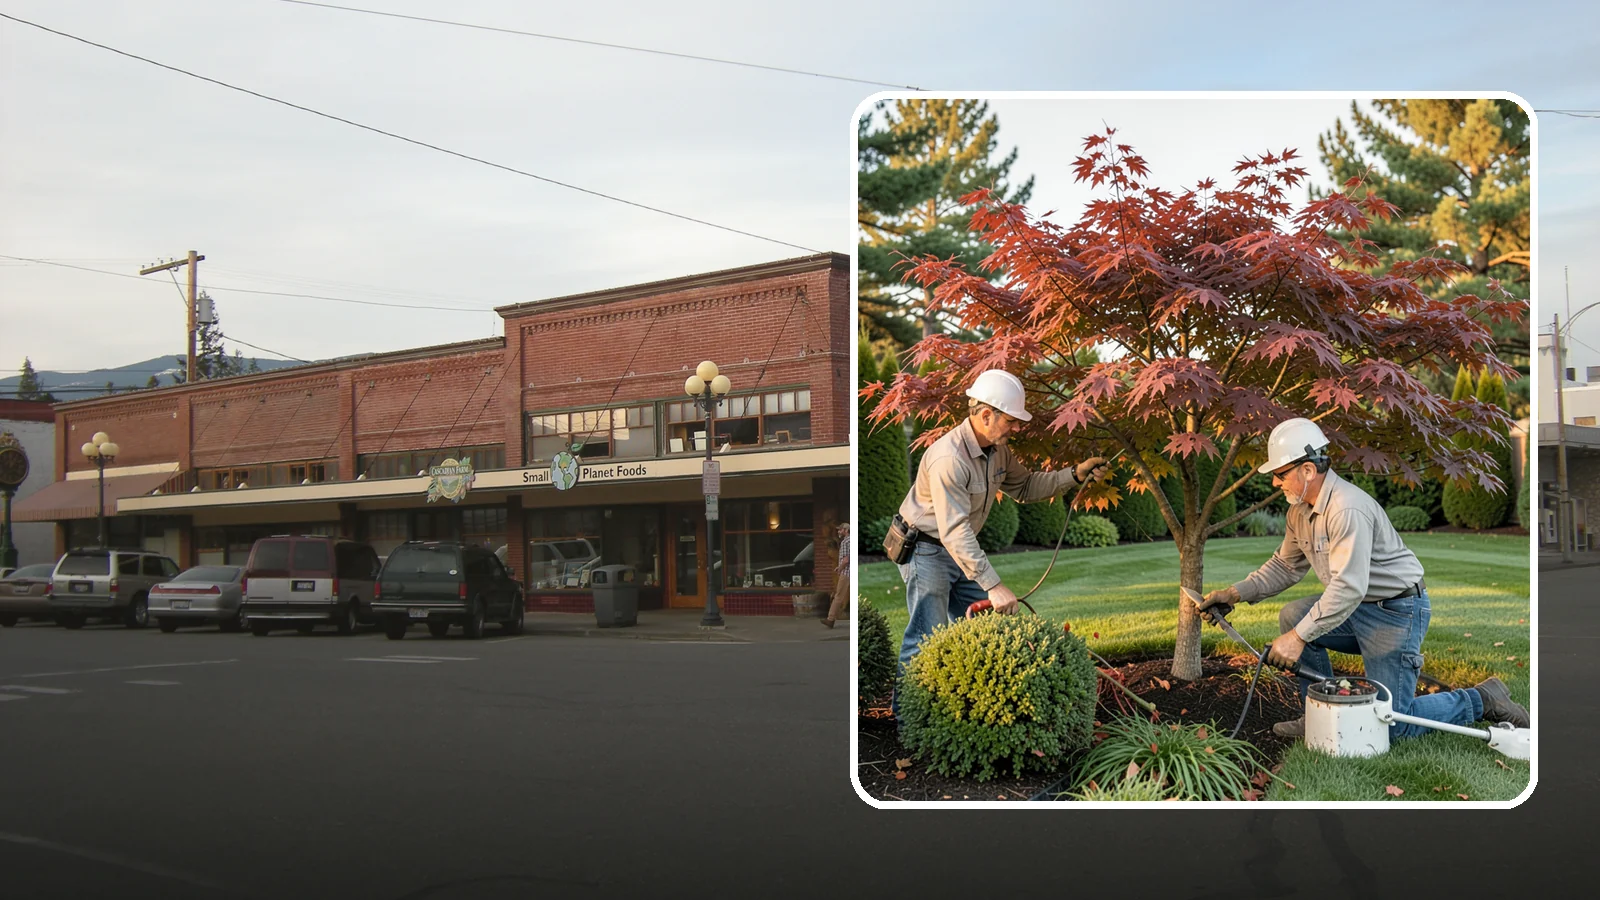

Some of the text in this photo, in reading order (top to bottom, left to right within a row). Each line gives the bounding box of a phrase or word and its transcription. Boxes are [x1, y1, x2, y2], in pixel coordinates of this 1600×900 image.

[523, 464, 647, 483] Small Planet Foods
